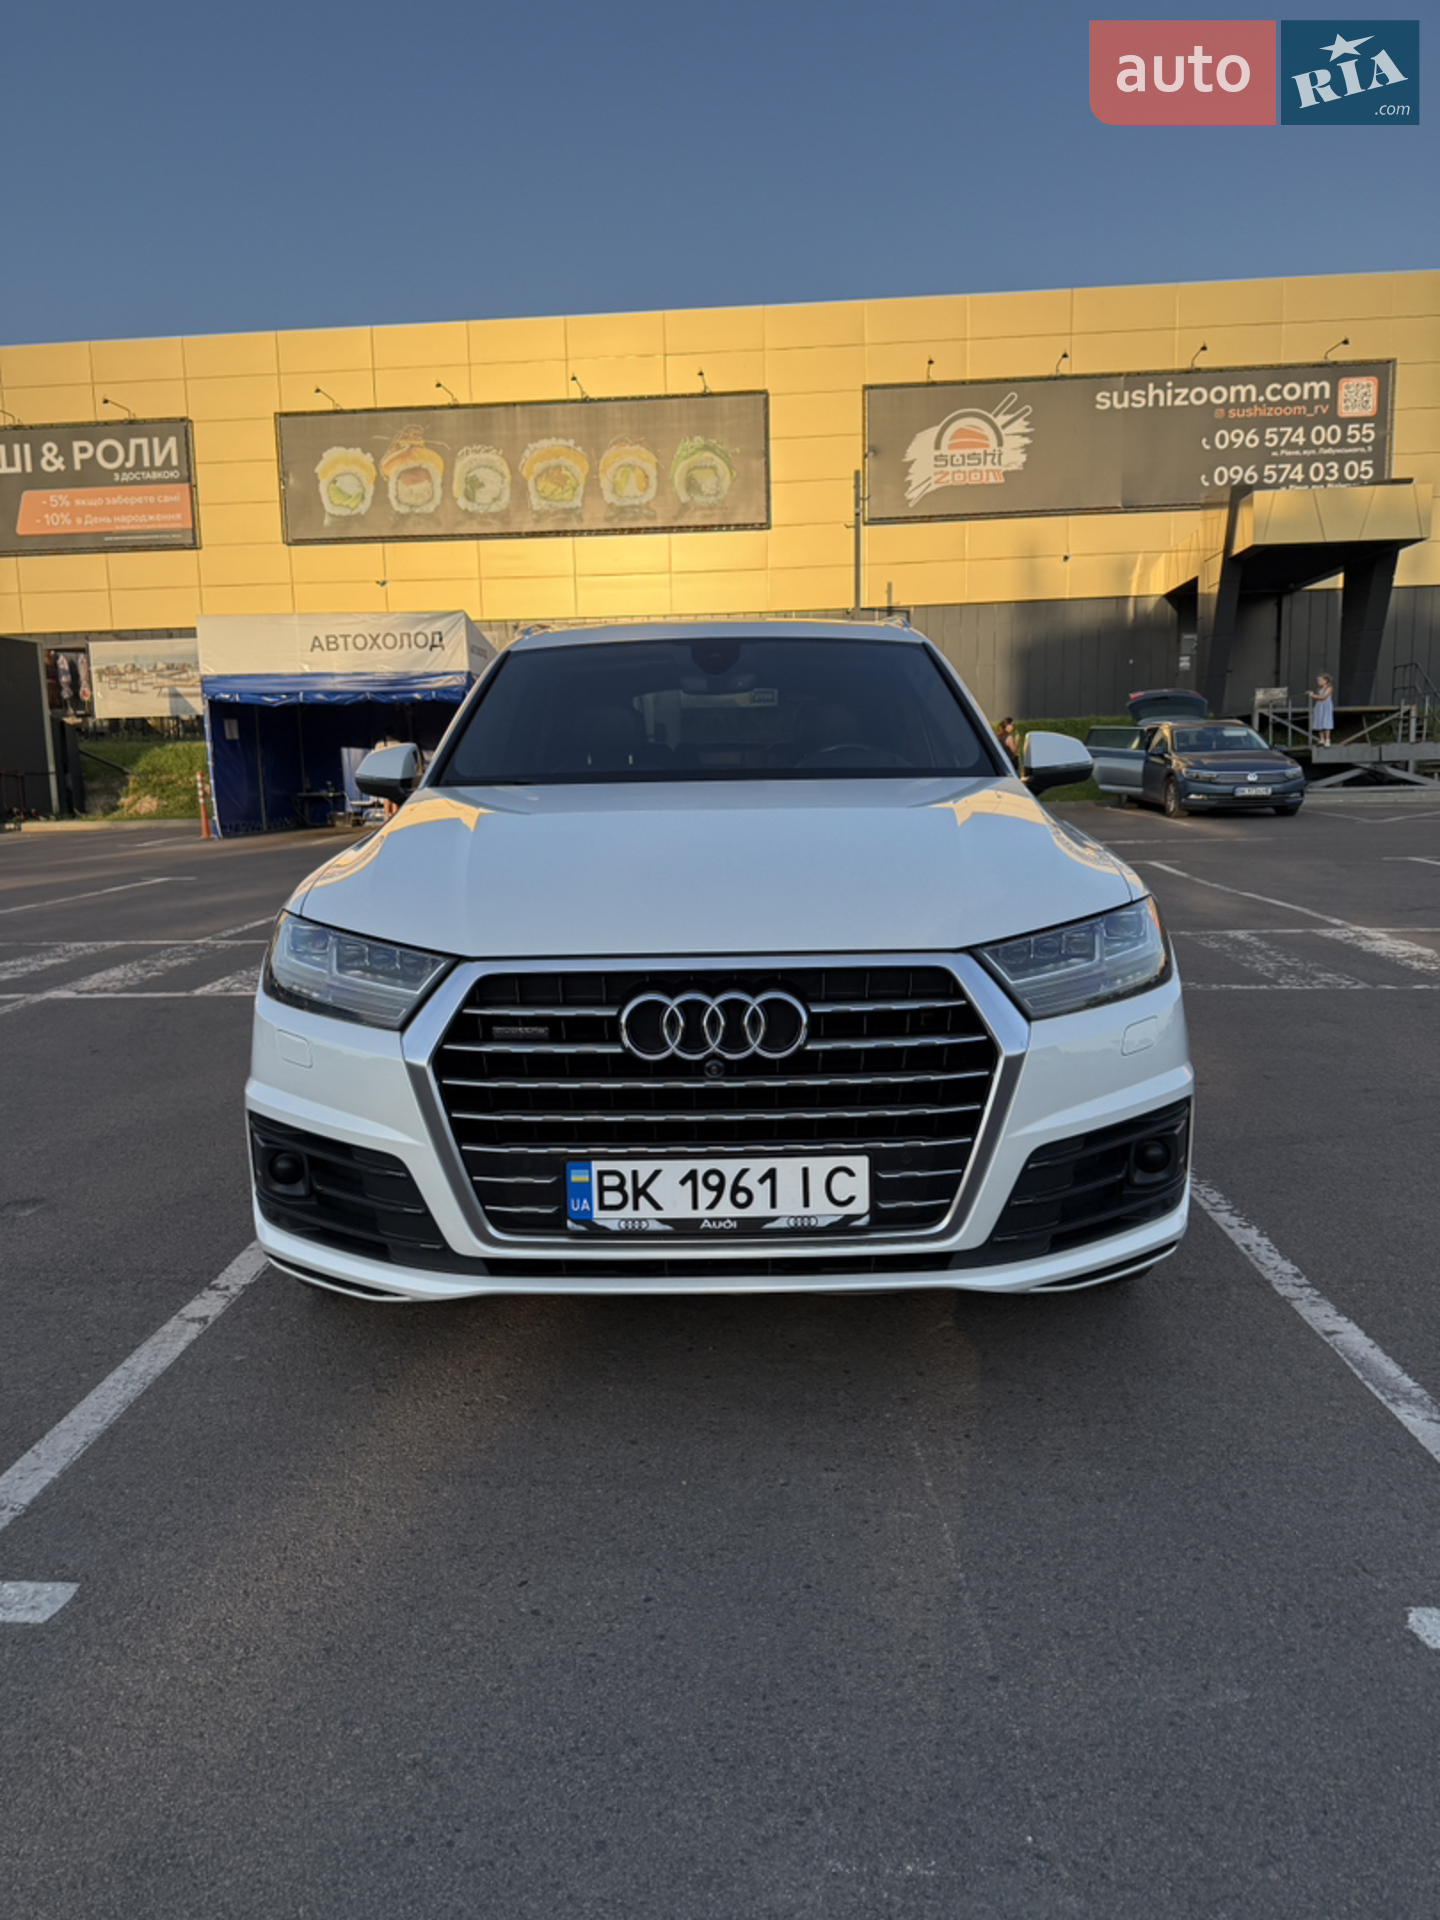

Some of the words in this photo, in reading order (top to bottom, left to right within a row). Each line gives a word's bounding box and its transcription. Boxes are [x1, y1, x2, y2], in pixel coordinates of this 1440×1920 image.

[1095, 380, 1331, 410] sushizoom.com
[1228, 404, 1330, 419] sushizoom_rv
[1214, 428, 1259, 449] 096
[1264, 426, 1305, 447] 574
[1310, 424, 1341, 445] 00
[1346, 423, 1375, 443] 55
[40, 442, 66, 473] &
[72, 436, 179, 470] РОЛИ
[1213, 465, 1258, 486] 096
[1263, 463, 1304, 484] 574
[1309, 462, 1339, 482] 03
[1344, 460, 1374, 480] 05
[310, 631, 445, 652] АВТОХОЛОД
[597, 1168, 664, 1212] BK
[678, 1166, 778, 1211] 1961
[801, 1165, 857, 1209] IC
[571, 1198, 591, 1212] UA
[700, 1218, 737, 1229] Audi
